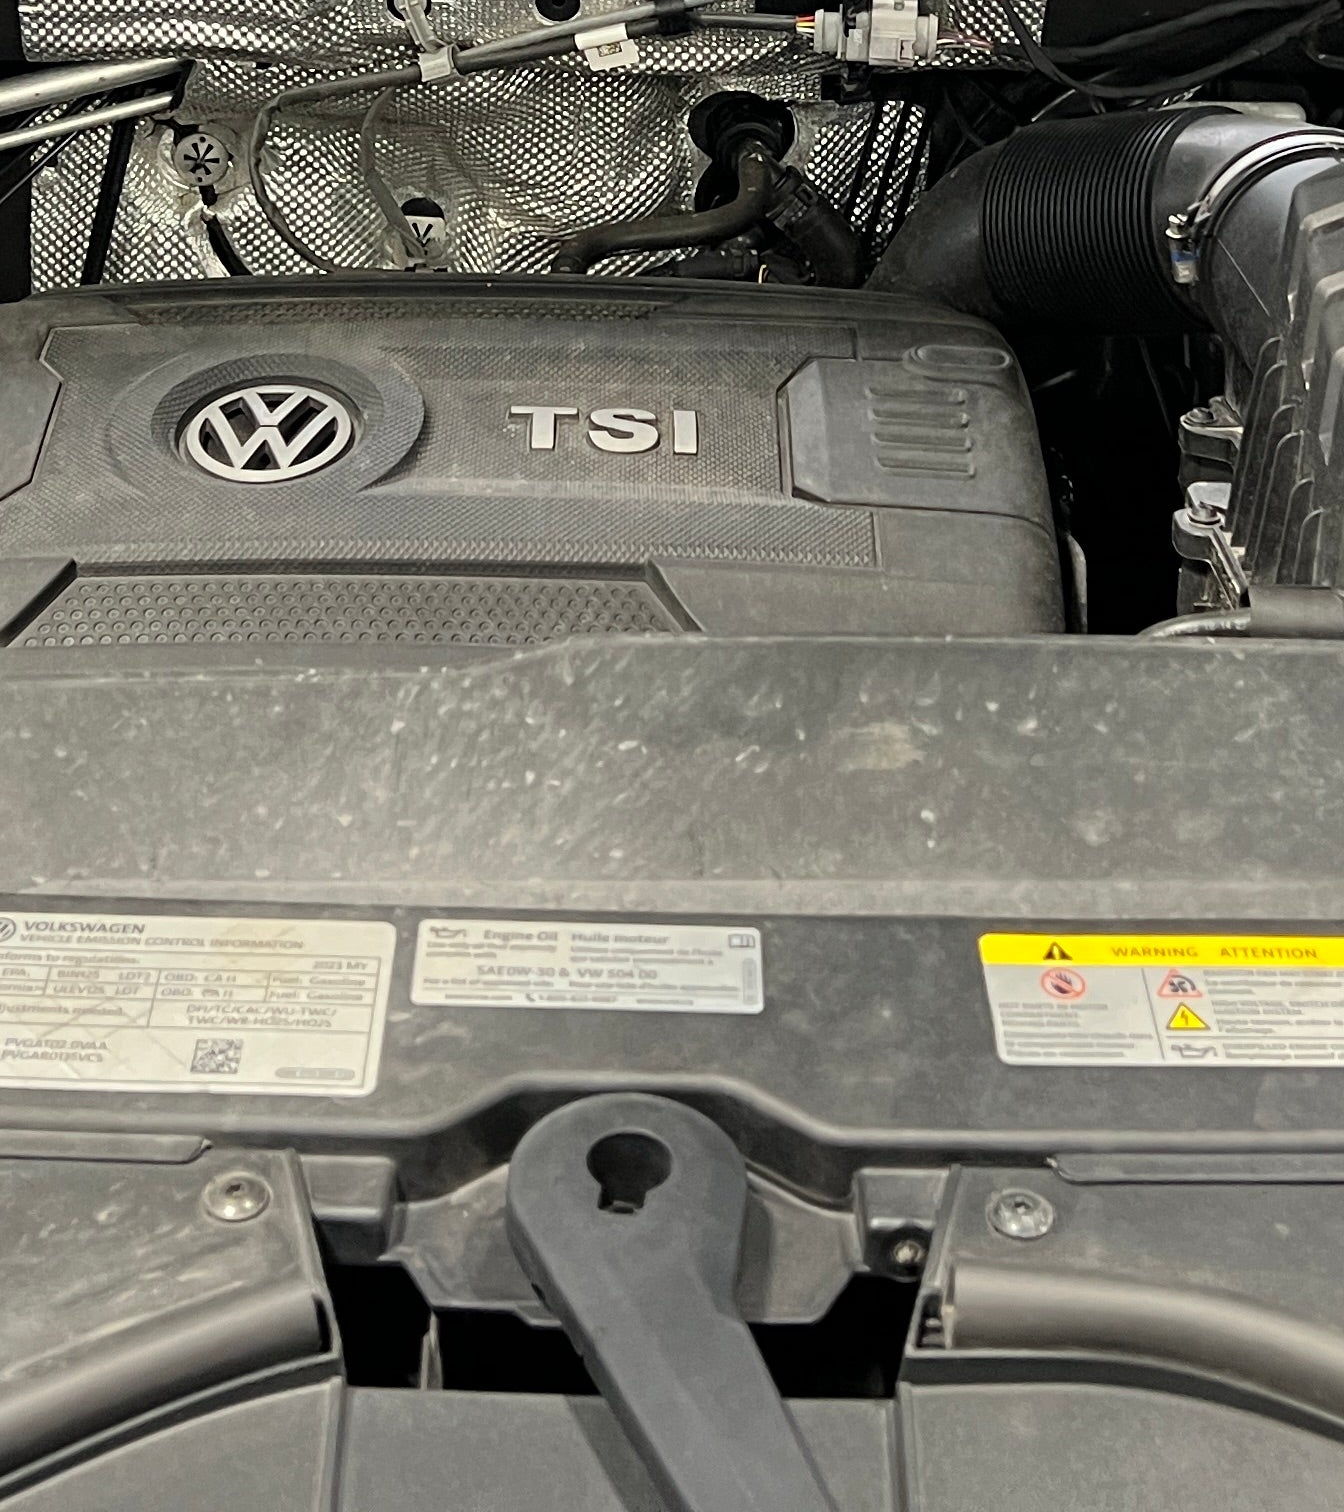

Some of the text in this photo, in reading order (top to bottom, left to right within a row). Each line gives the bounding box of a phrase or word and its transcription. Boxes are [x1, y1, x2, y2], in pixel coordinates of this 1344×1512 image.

[510, 405, 698, 454] TSI
[24, 921, 146, 934] VOLKSWAGEN
[20, 934, 304, 949] VEHICLE EMISSION CONTROL INFORMATION
[484, 930, 558, 941] Engine Oil
[571, 932, 671, 944] Huile moteur
[45, 953, 60, 963] to
[1110, 946, 1319, 959] WARNING ATTENTION
[477, 966, 504, 976] SAE
[558, 967, 570, 978] &
[577, 968, 604, 978] VW
[607, 968, 635, 979] 504
[309, 976, 366, 987] Gasoline
[306, 991, 363, 1002] Gasoline
